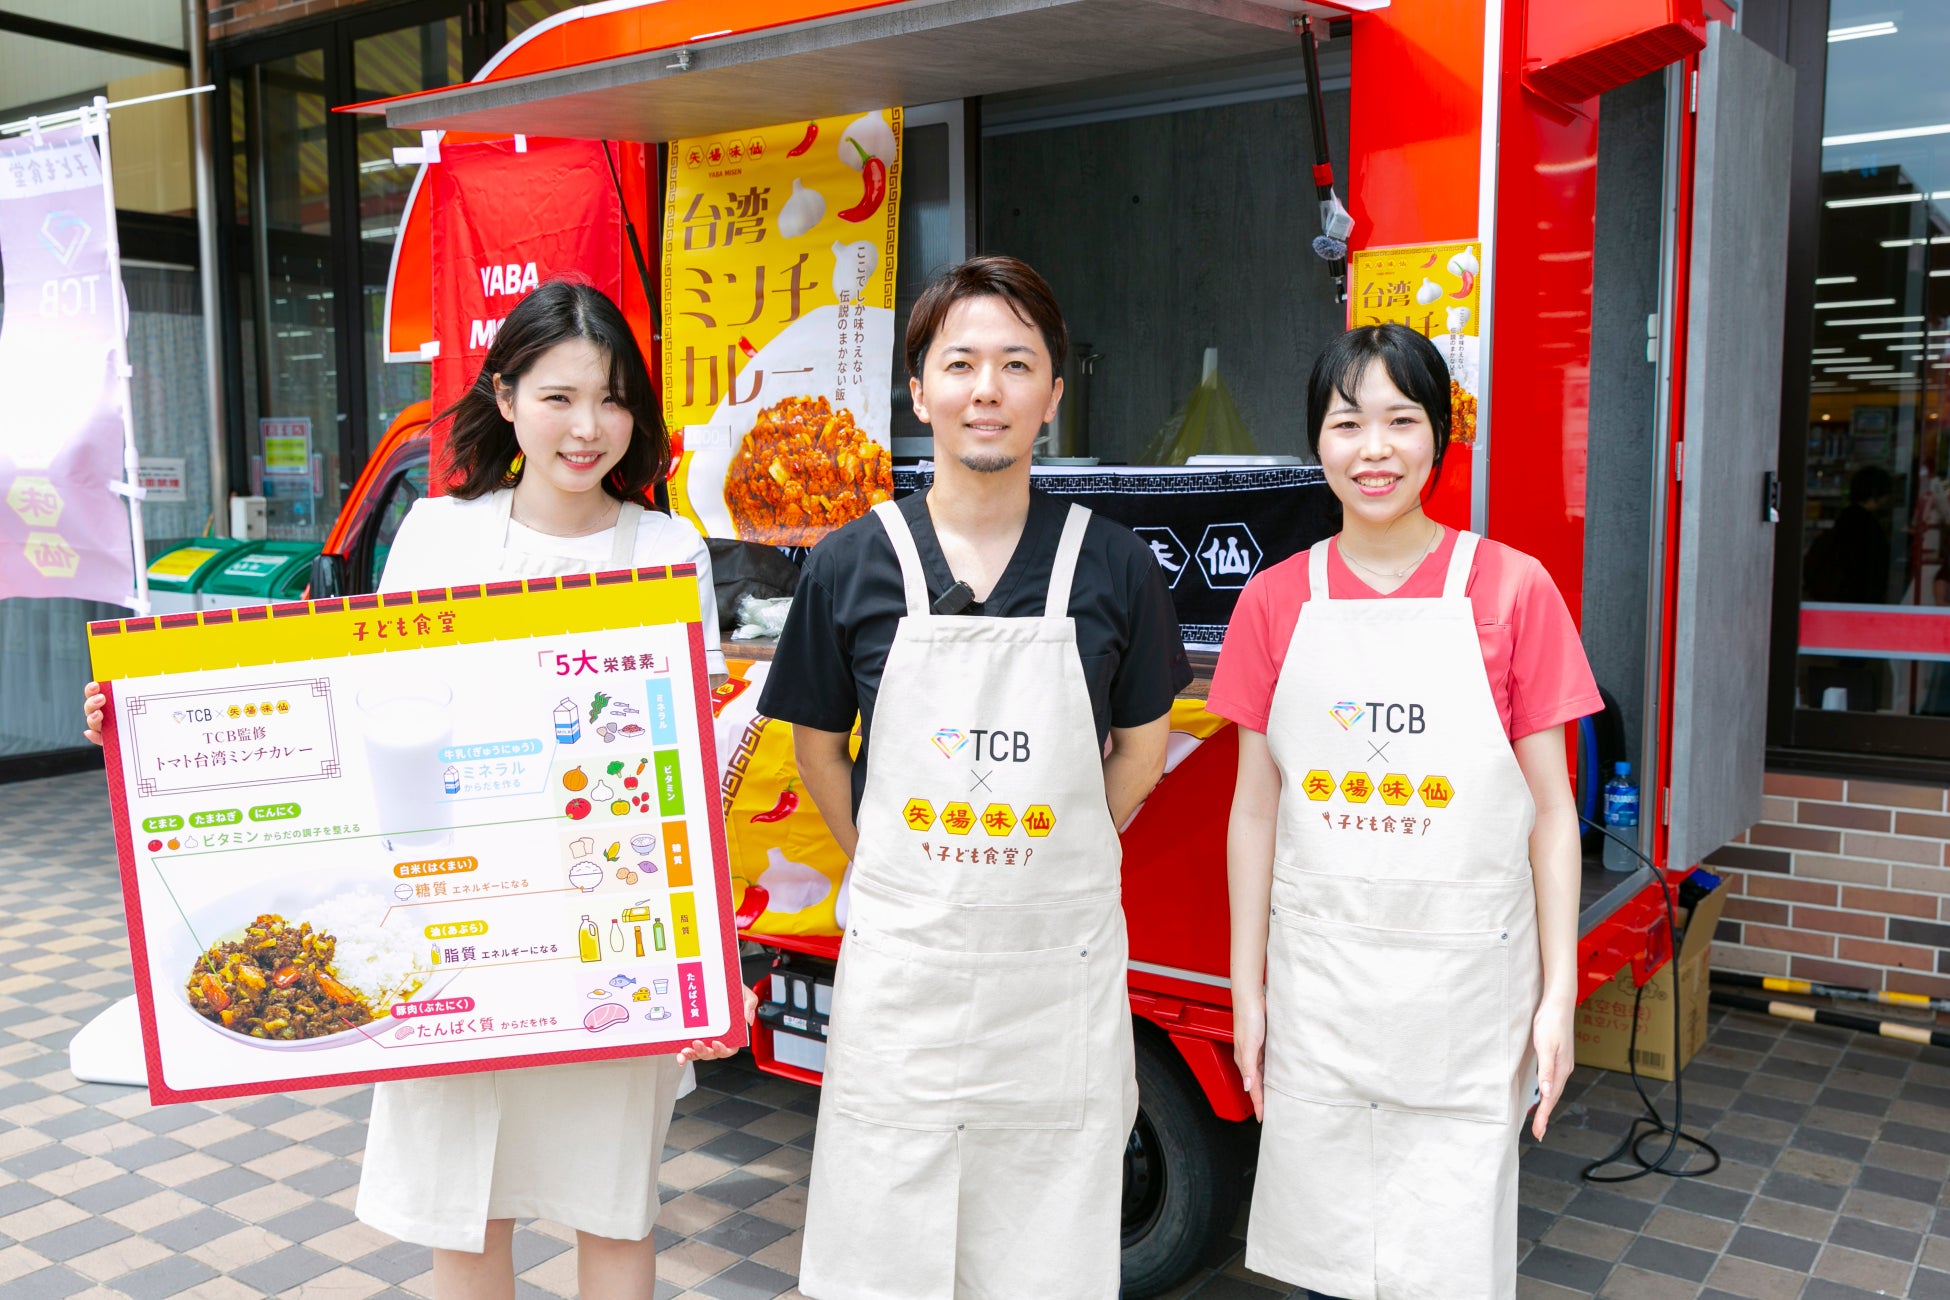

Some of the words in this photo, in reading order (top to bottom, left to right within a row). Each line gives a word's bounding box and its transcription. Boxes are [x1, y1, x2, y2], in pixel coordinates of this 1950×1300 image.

[689, 141, 763, 164] 矢場味仙
[682, 187, 771, 250] 台湾
[480, 262, 539, 298] YABA
[680, 253, 819, 328] ミンチ
[1363, 280, 1411, 308] 台湾
[852, 247, 866, 386] ここでしか味わえない
[835, 290, 850, 401] 伝説のまかない飯
[680, 344, 814, 407] カレー
[353, 610, 456, 642] 子ども食堂
[186, 708, 212, 723] TCB
[229, 702, 290, 718] 矢場味仙
[656, 694, 667, 729] ミネラル
[1366, 702, 1426, 734] TCB
[203, 726, 266, 744] TCB監修
[969, 729, 1031, 763] TCB
[156, 747, 313, 771] トマト台湾ミンチカレー
[464, 761, 525, 778] ミネラル
[664, 765, 675, 801] ビタミン
[1308, 776, 1449, 802] 矢場味仙
[148, 818, 178, 829] とまと
[194, 811, 237, 826] たまねぎ
[254, 805, 295, 819] にんにく
[908, 805, 1051, 830] 矢場味仙
[1337, 814, 1417, 834] 子ども食堂
[203, 831, 258, 848] ビタミン
[263, 824, 361, 841] からだの調子を整える
[400, 859, 473, 876] 白米(はくまい)
[936, 846, 1019, 866] 子ども食堂
[415, 881, 448, 898] 糖質
[452, 879, 529, 894] エネルギーになる
[681, 915, 690, 935] 脂質
[444, 946, 476, 963] 脂質
[481, 944, 558, 960] エネルギーになる
[395, 998, 469, 1016] 豚肉(ぶたにく)
[686, 973, 700, 1018] たんぱく質
[417, 1017, 495, 1038] たんぱく質
[500, 1016, 558, 1030] からだを作る
